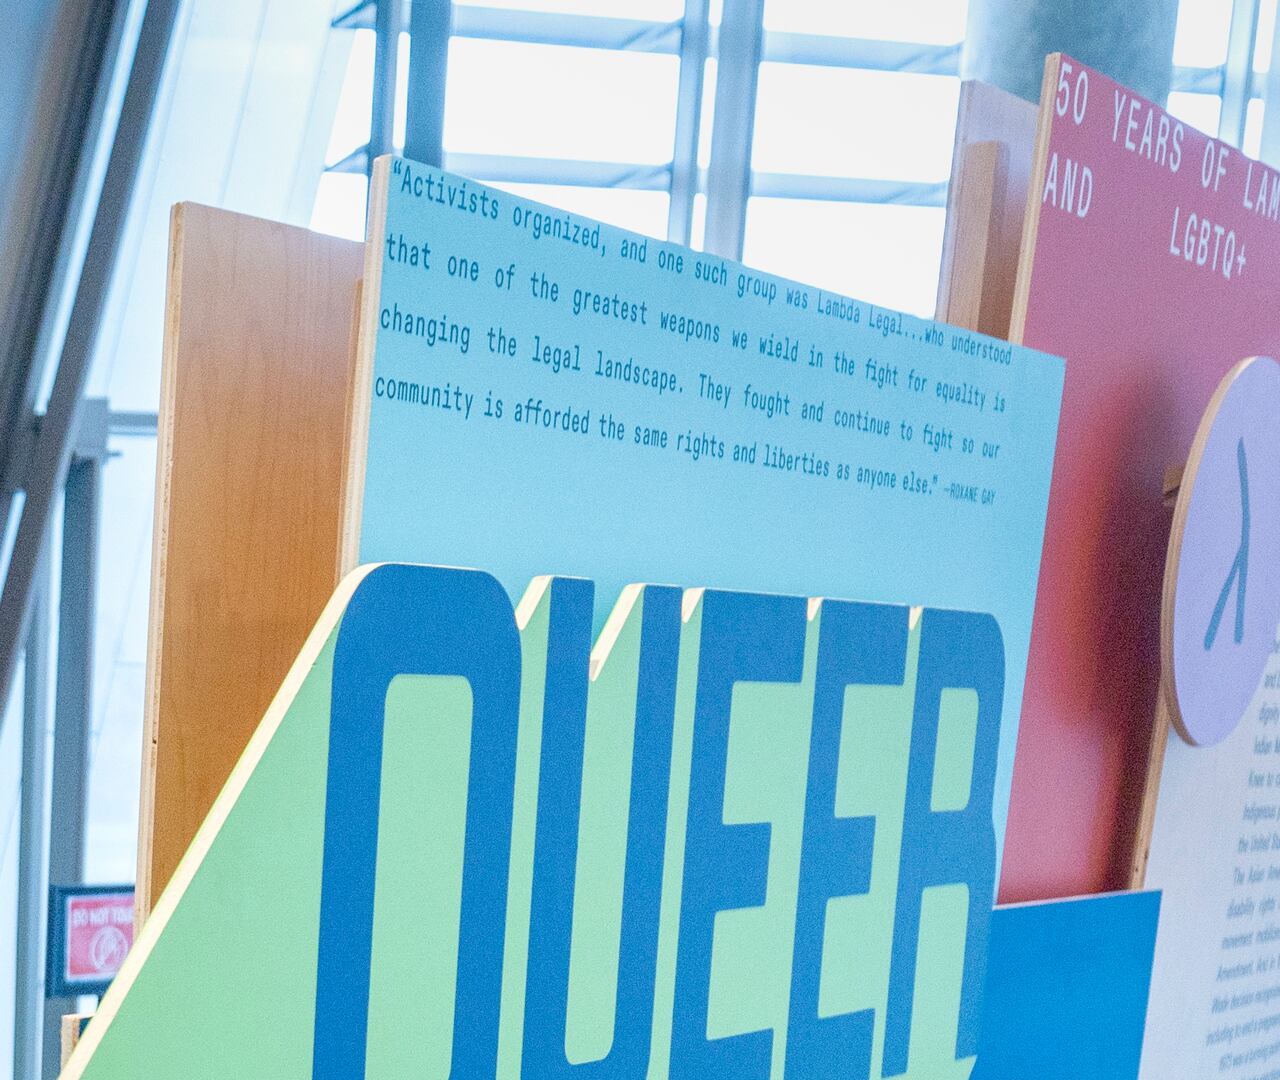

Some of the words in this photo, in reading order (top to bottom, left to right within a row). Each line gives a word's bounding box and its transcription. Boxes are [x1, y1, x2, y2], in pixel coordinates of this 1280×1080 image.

[1056, 62, 1089, 125] 50
[1113, 90, 1184, 173] YEARS
[1202, 139, 1230, 192] OF
[1043, 153, 1093, 218] AND
[1169, 206, 1246, 280] LGBTQ+
[385, 231, 432, 271] that
[446, 254, 480, 283] one
[494, 262, 517, 291] of
[529, 271, 560, 303] the
[572, 288, 648, 326] greatest
[659, 311, 721, 344] weapons
[731, 329, 749, 351] we
[758, 333, 800, 363] wield
[807, 344, 824, 369] in
[833, 351, 856, 377] the
[864, 357, 899, 390] fight
[907, 368, 929, 393] for
[935, 381, 987, 411] equality
[992, 395, 1006, 414] is
[512, 205, 607, 258] organized,
[619, 238, 648, 264] and
[657, 248, 685, 275] one
[693, 260, 729, 287] such
[736, 272, 781, 306] group
[785, 289, 809, 311] was
[816, 298, 861, 325] Lambda
[951, 336, 1013, 366] understood
[374, 375, 475, 421] community
[482, 389, 504, 420] is
[513, 397, 591, 435] afforded
[598, 413, 626, 442] the
[633, 425, 669, 450] same
[676, 429, 726, 462] rights
[732, 441, 758, 465] and
[762, 443, 830, 478] liberties
[835, 462, 851, 481] as
[856, 466, 897, 490] anyone
[980, 488, 996, 505] GAY
[379, 301, 471, 355] changing
[486, 326, 518, 358] the
[531, 334, 582, 375] legal
[594, 349, 684, 396] landscape.
[698, 372, 732, 410] They
[743, 383, 791, 420] fought
[800, 400, 825, 424] and
[833, 409, 891, 437] continue
[899, 420, 914, 442] to
[922, 422, 954, 454] fight
[961, 437, 975, 455] so
[981, 441, 1001, 459] our
[90, 908, 109, 925] NOT
